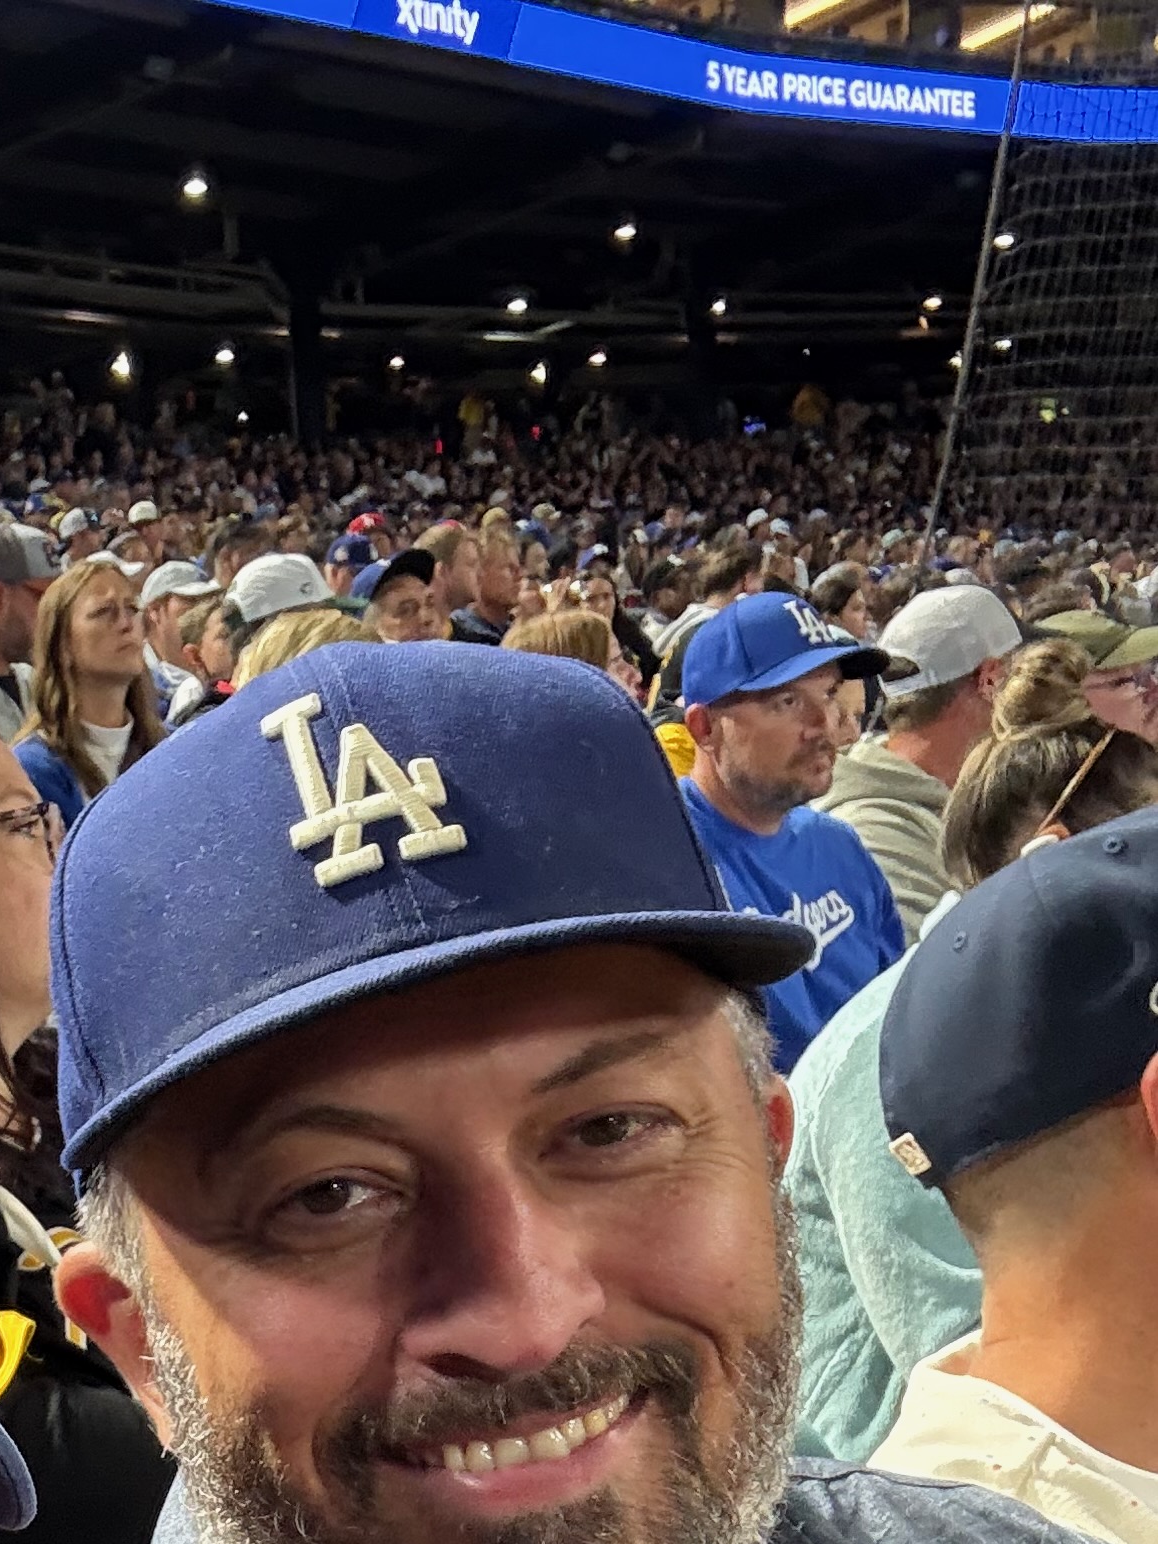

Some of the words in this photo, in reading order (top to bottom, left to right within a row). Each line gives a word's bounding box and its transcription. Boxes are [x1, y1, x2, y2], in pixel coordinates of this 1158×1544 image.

[706, 60, 721, 91] 5
[722, 63, 778, 101] YEAR
[782, 71, 847, 107] PRICE
[849, 79, 976, 119] GUARANTEE
[782, 600, 833, 646] LA
[260, 693, 468, 888] LA
[743, 888, 855, 973] dgers
